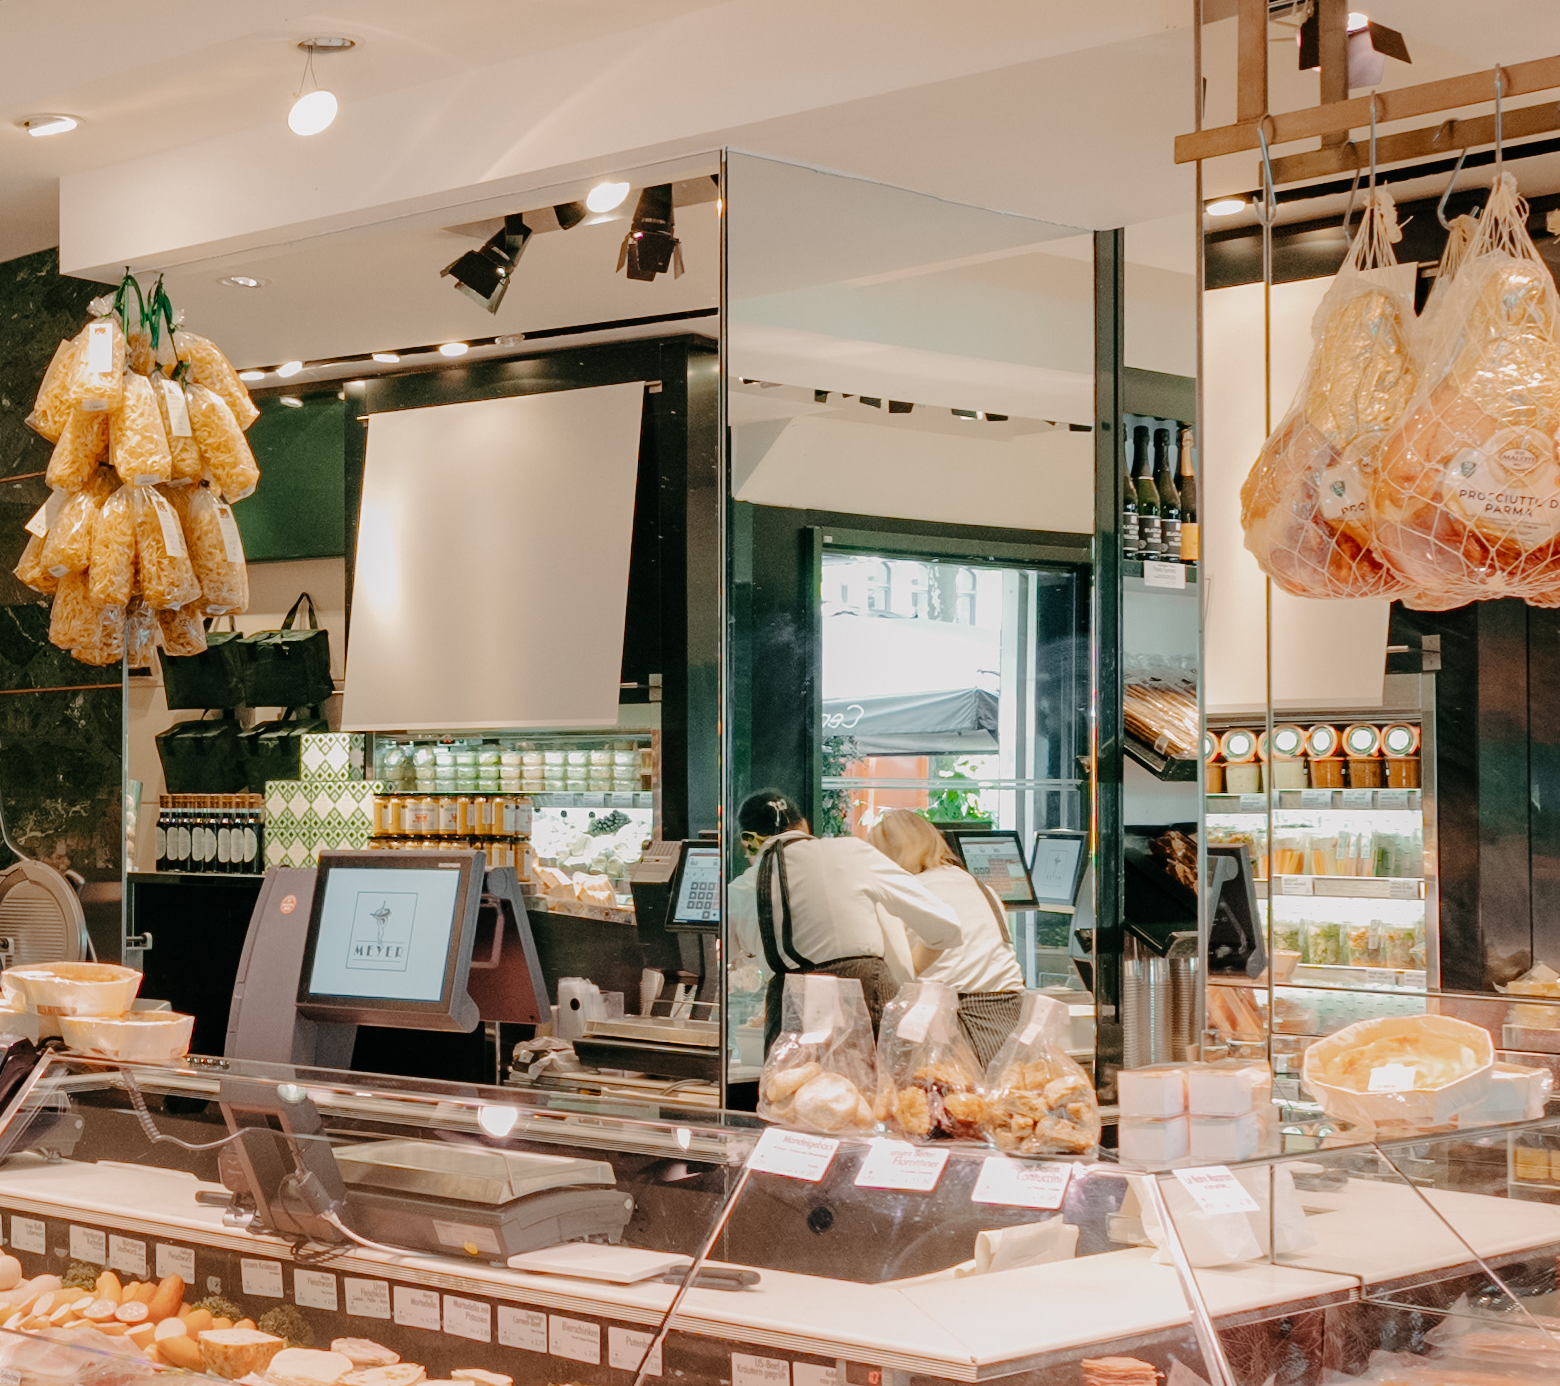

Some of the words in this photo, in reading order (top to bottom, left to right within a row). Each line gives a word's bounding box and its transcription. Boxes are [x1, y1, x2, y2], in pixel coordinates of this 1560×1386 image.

[1458, 489, 1543, 508] PROSCIUTTO
[1484, 503, 1534, 517] PARMA
[353, 944, 404, 958] MEYER
[892, 1156, 940, 1168] Florentiner
[562, 1321, 599, 1338] Bierschinken
